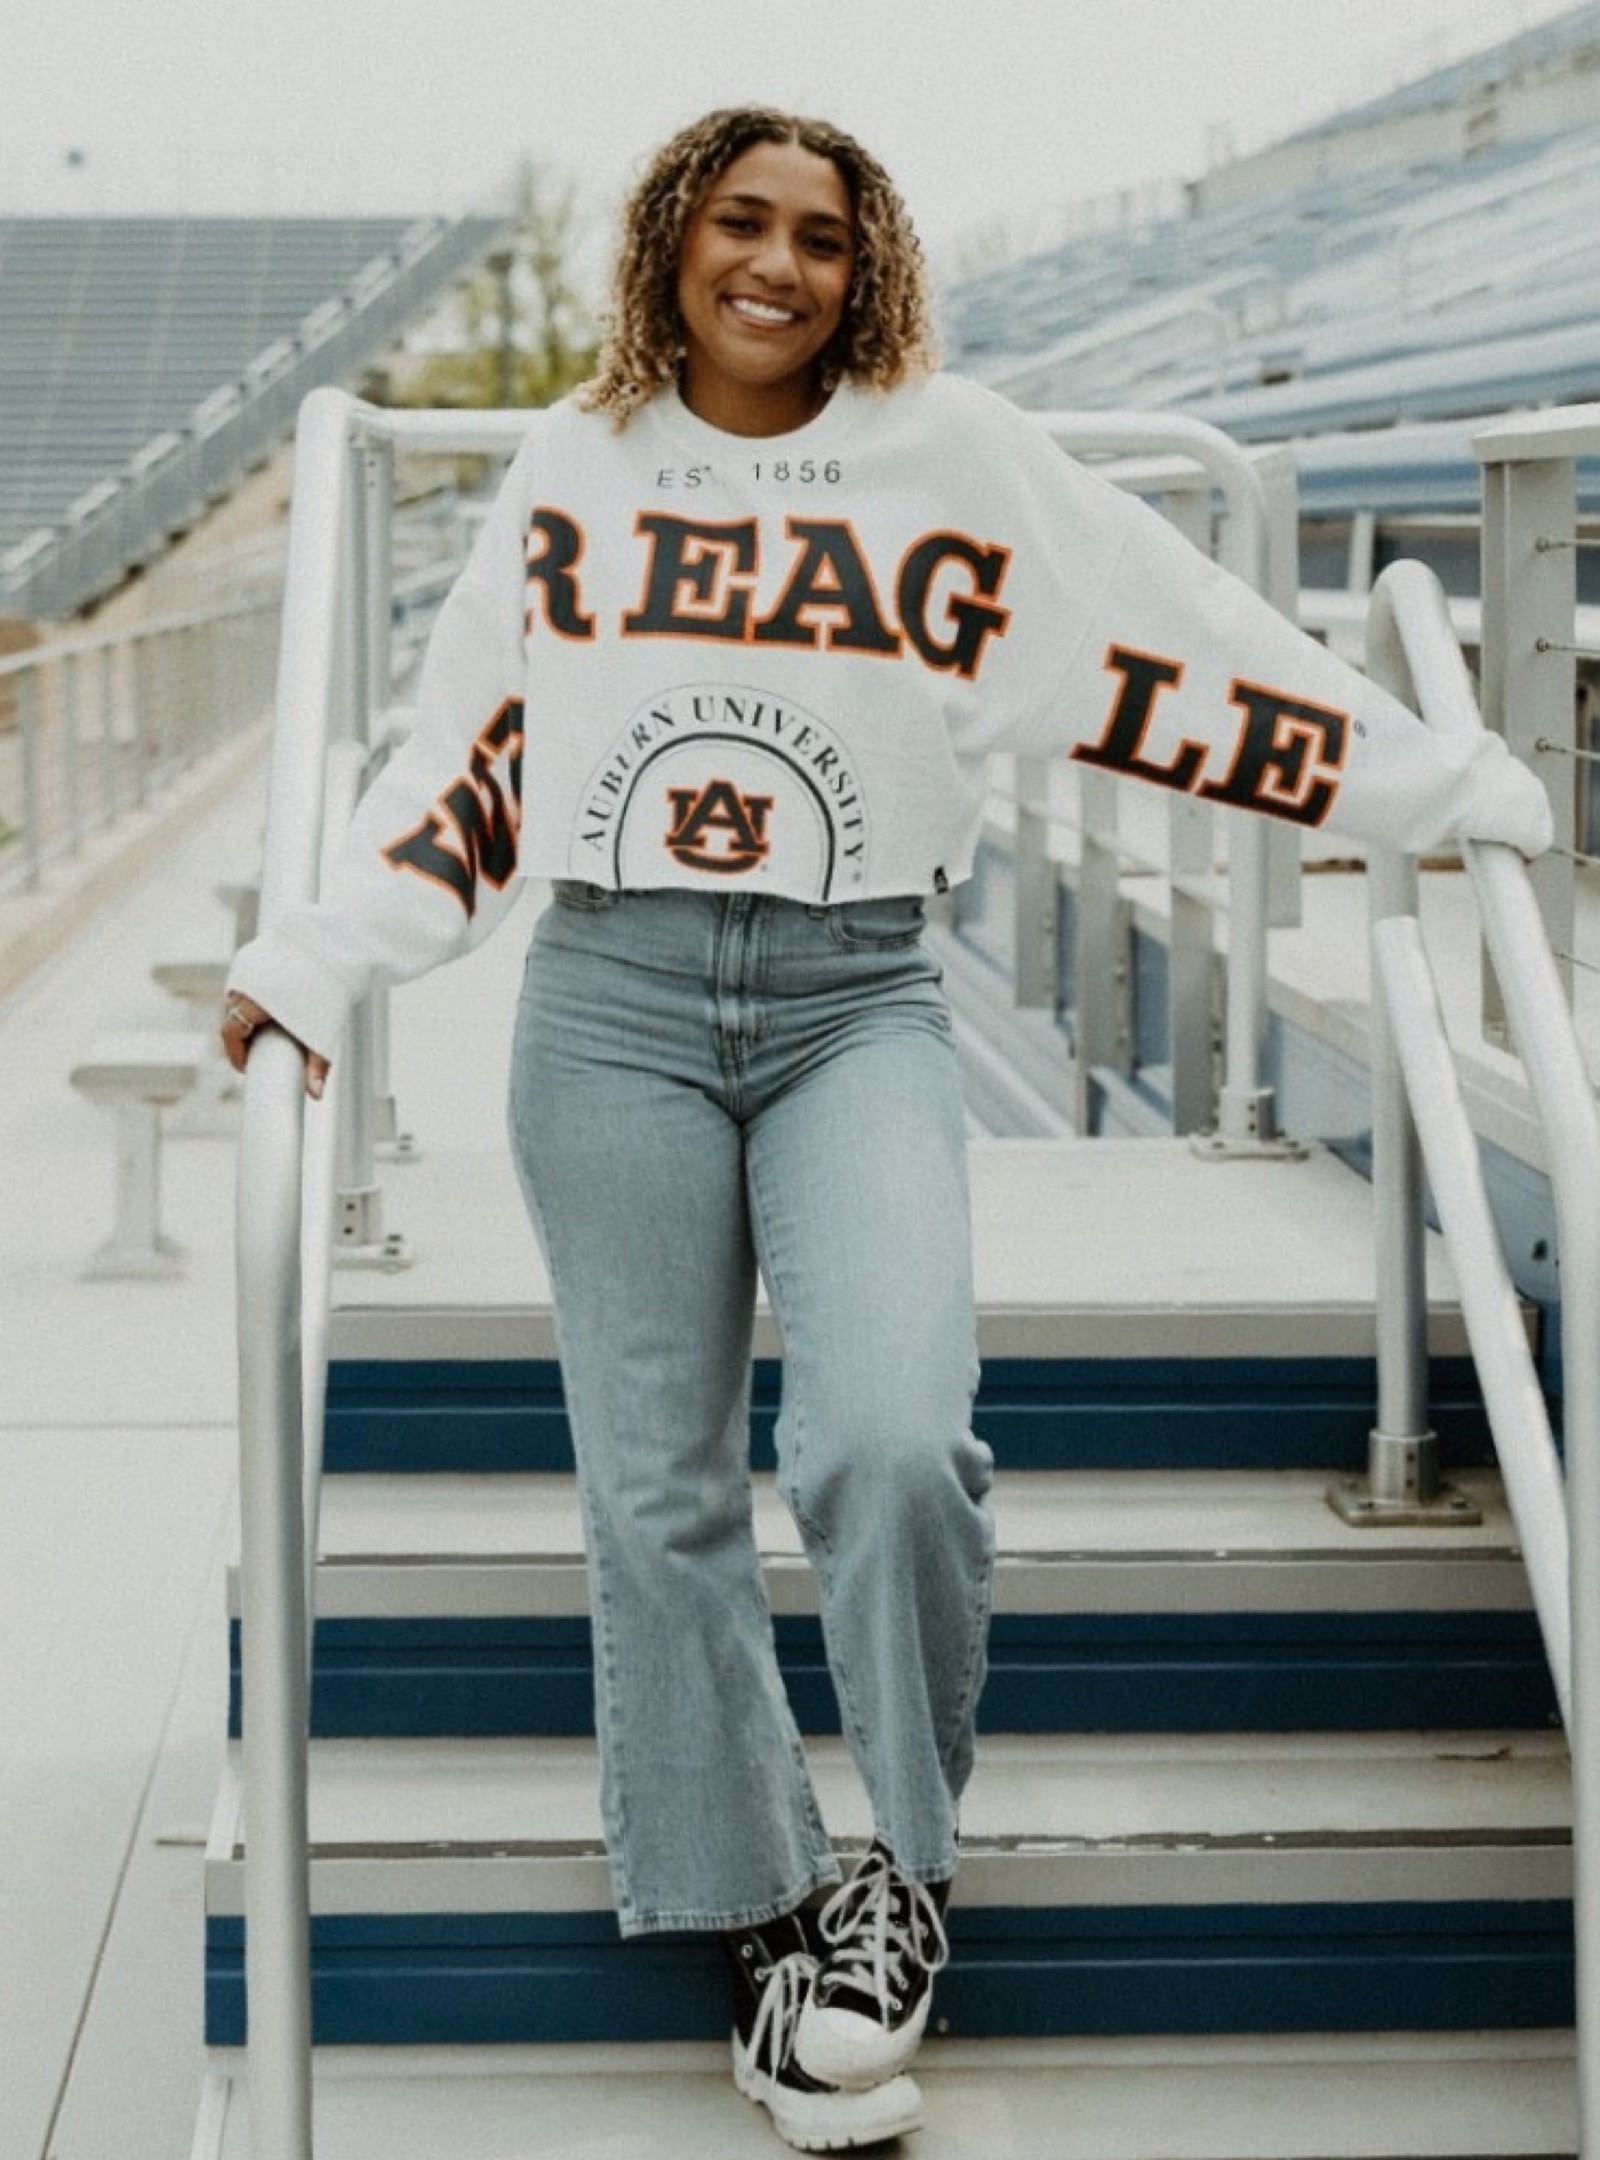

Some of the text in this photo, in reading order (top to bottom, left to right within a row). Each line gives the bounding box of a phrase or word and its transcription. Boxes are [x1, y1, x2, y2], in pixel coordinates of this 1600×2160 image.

[754, 459, 841, 483] 1856
[580, 696, 864, 864] AUBURN UNIVERSITY
